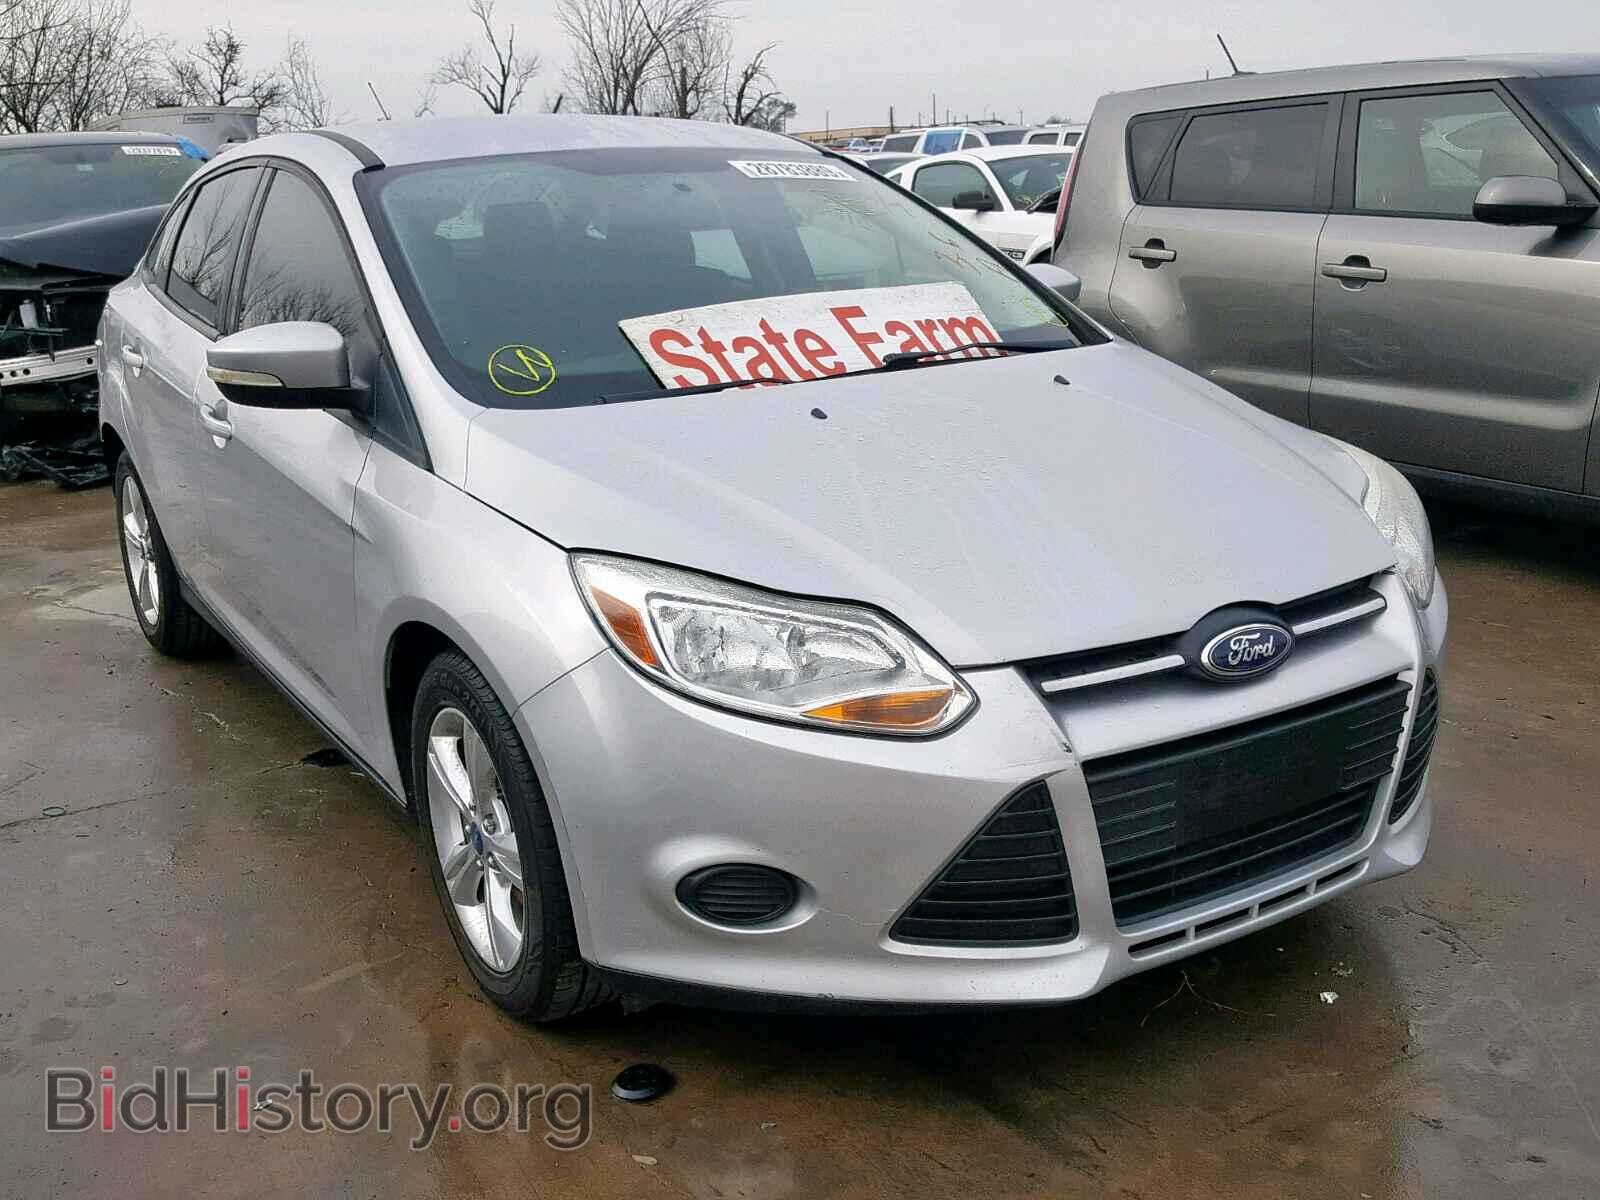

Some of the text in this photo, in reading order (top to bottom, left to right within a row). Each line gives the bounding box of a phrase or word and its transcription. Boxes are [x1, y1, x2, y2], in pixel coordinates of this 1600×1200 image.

[648, 318, 847, 389] State
[829, 305, 1007, 368] Farm
[1228, 632, 1276, 666] Ford
